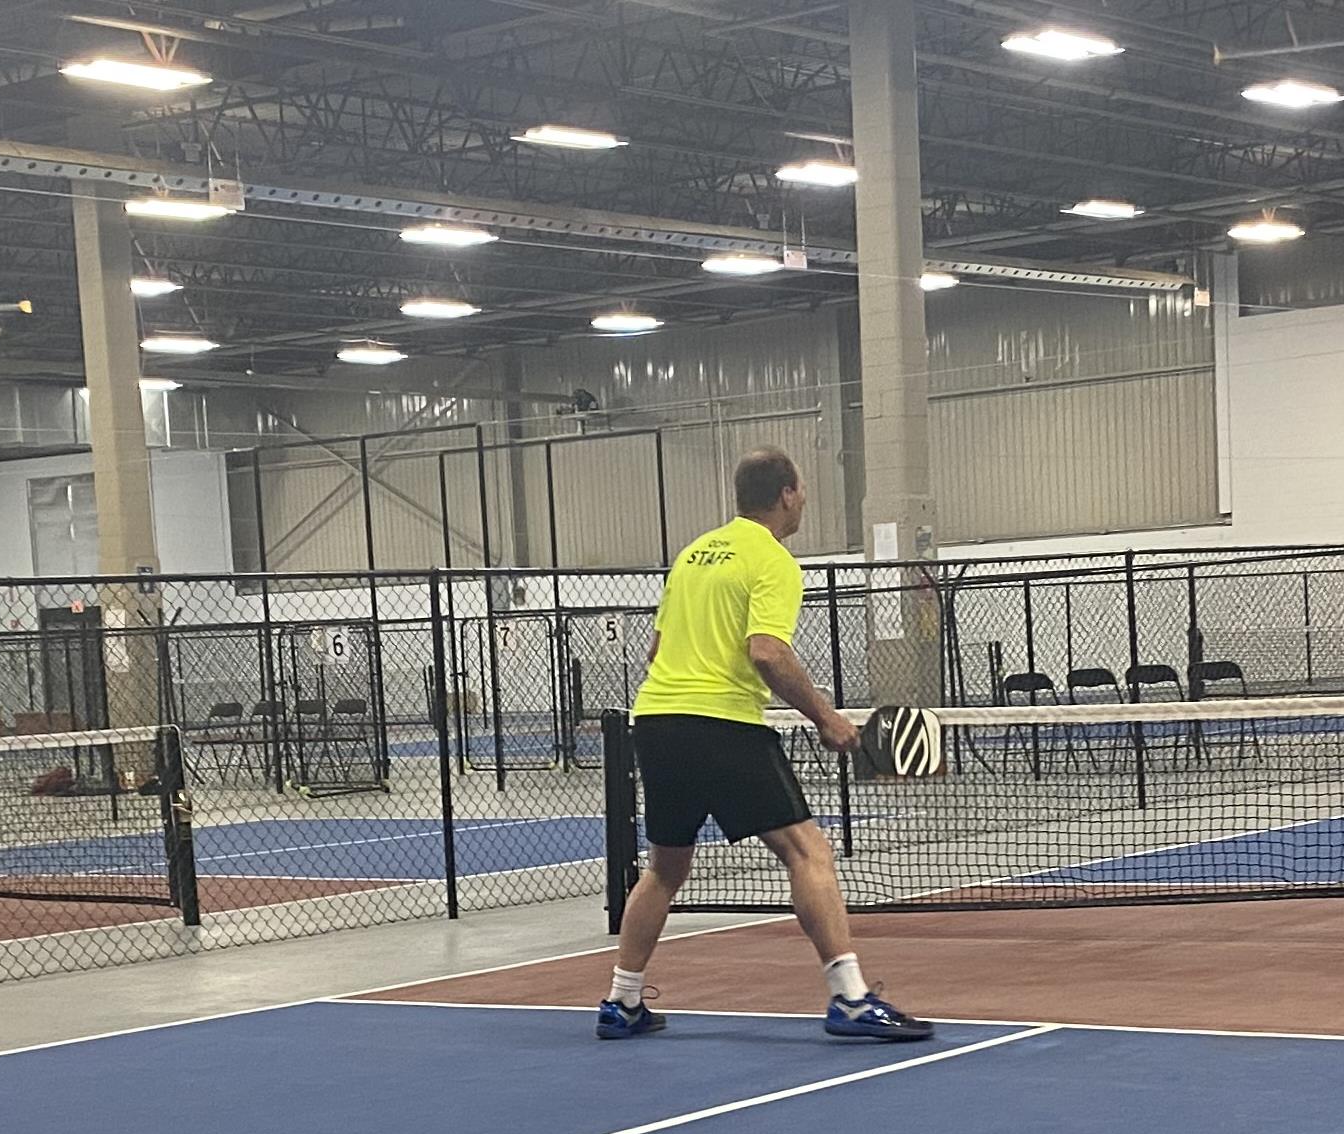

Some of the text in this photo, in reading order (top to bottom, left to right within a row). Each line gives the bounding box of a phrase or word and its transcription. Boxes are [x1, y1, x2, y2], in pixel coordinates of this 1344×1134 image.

[687, 551, 736, 565] STAFF
[500, 627, 510, 646] 7
[606, 621, 616, 641] 5
[333, 634, 343, 656] 6
